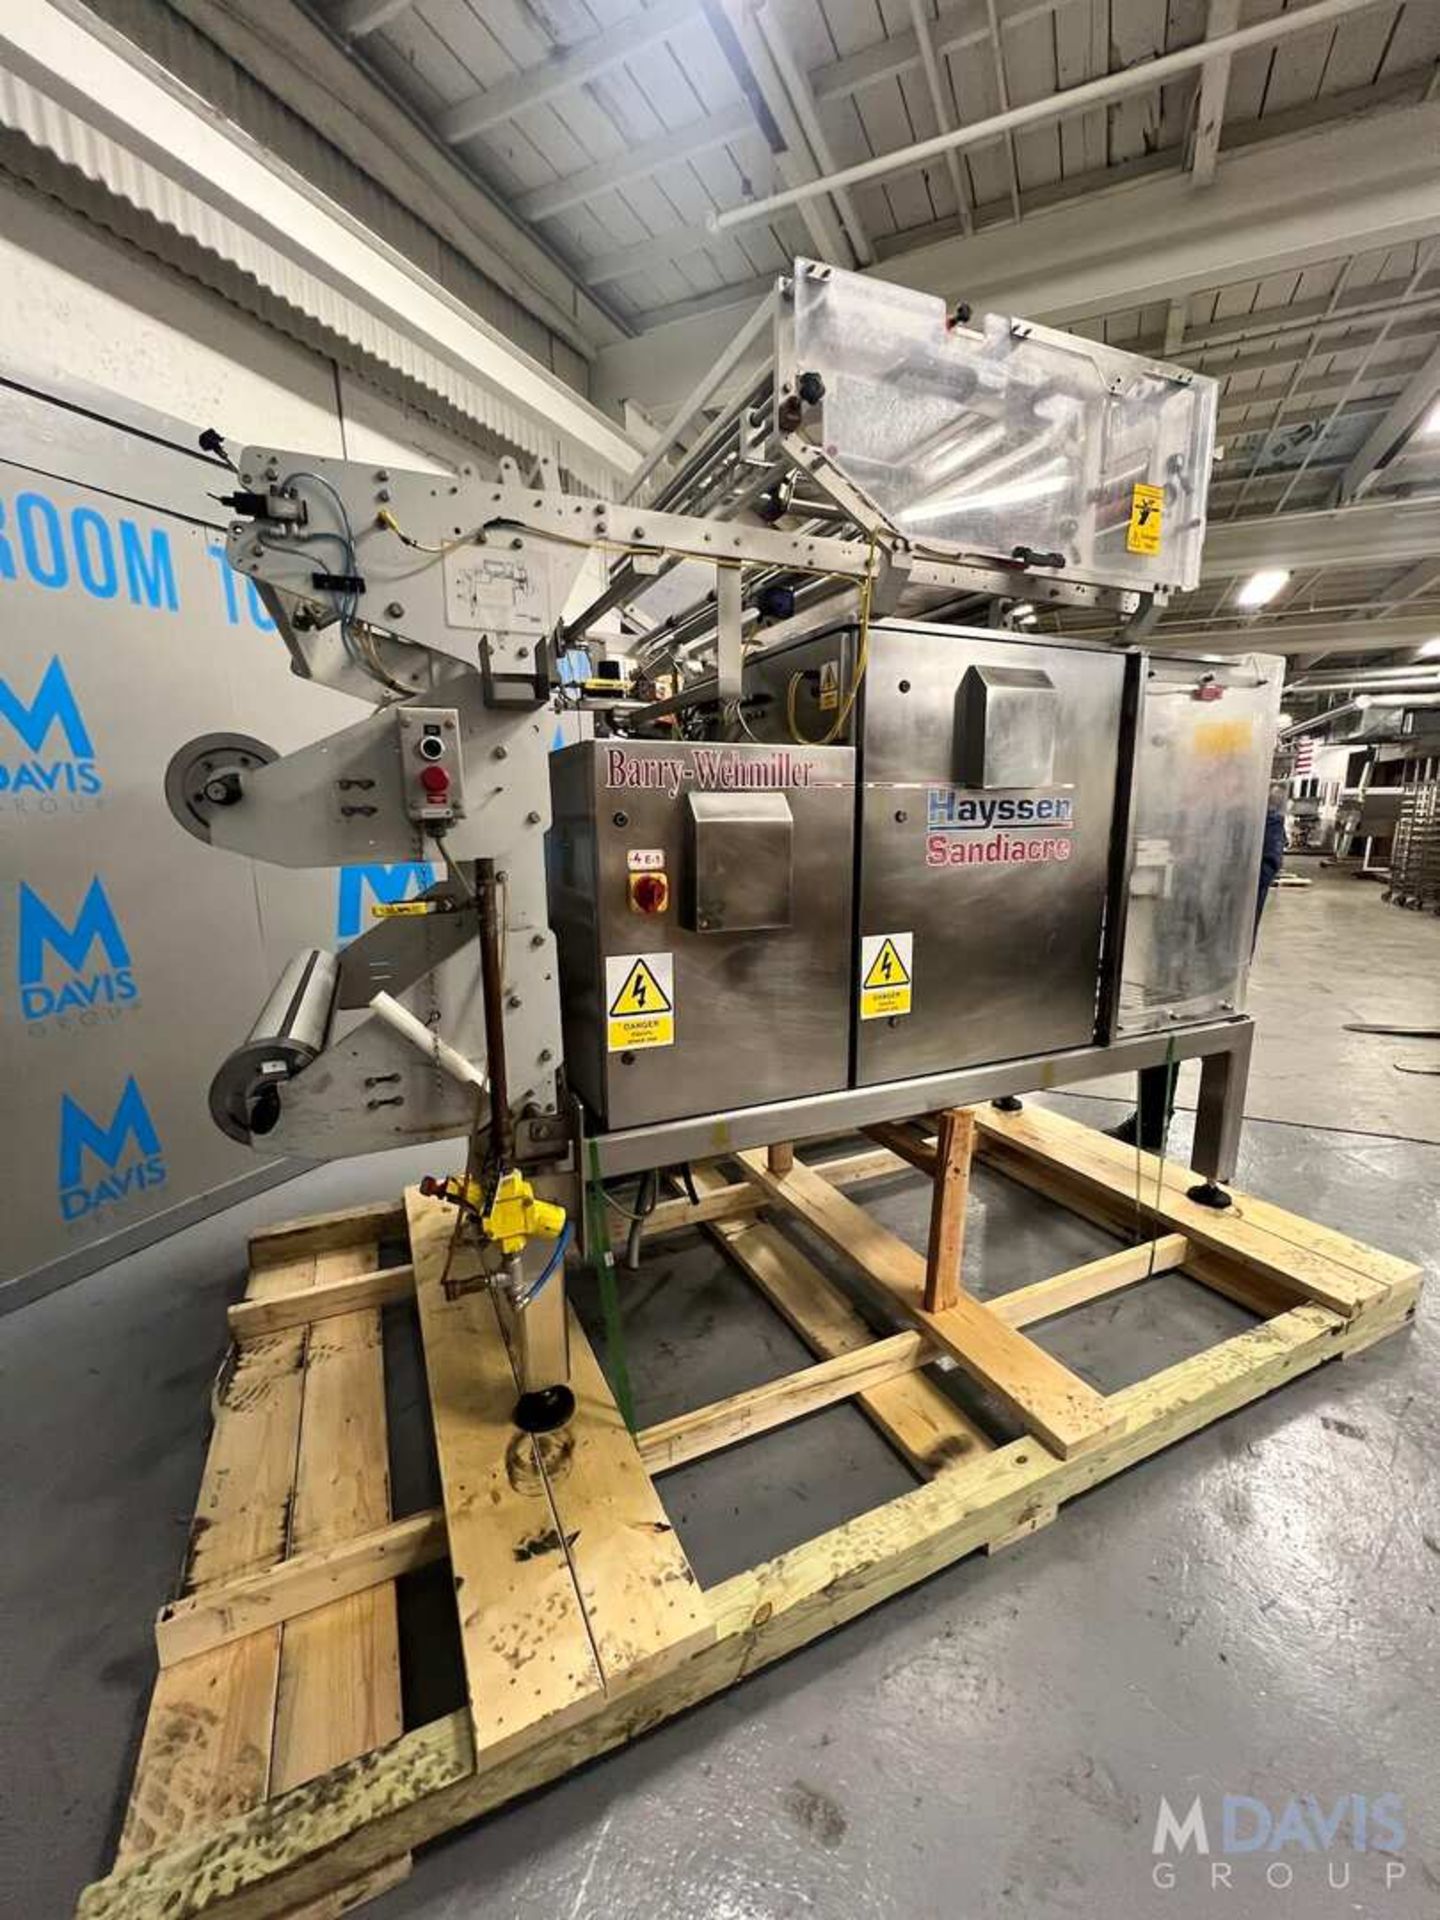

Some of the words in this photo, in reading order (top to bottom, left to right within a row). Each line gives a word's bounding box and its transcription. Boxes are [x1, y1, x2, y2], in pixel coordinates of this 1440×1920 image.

[605, 747, 813, 799] Barry-Wehmiller
[928, 790, 1072, 830] Hayssen
[927, 834, 1074, 866] Sandiacre
[19, 874, 132, 985] M
[21, 970, 137, 1020] DAVIS
[58, 1074, 163, 1189] M
[61, 1157, 166, 1222] DAVIS
